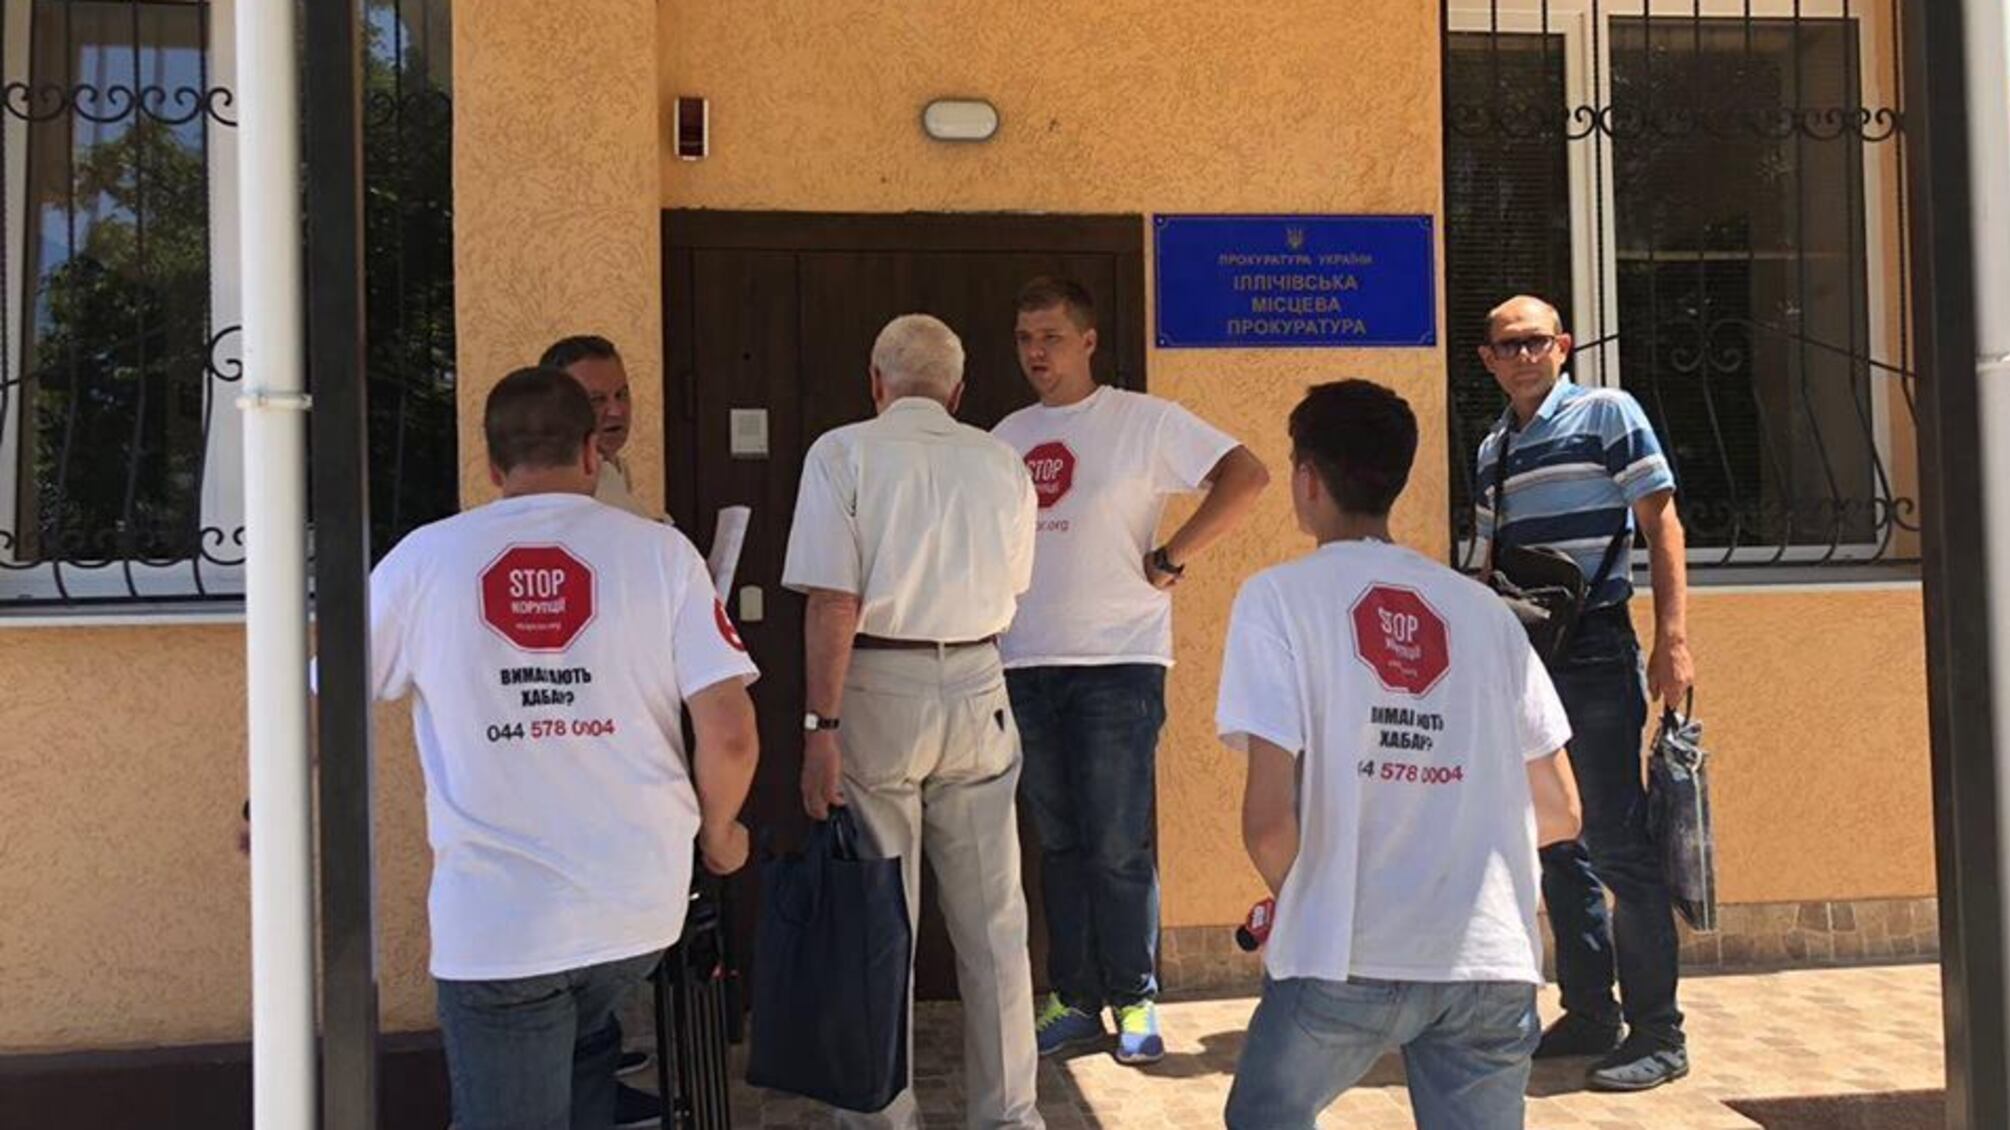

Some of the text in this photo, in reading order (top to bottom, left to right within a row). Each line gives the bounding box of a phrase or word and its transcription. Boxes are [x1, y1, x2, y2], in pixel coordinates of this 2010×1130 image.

[1218, 252, 1372, 265] ПРОКУРАТУРА УКРАЇНИ
[1233, 274, 1358, 291] ІЛЛІЧІВСЬКА
[1251, 296, 1341, 314] МІСЦЕВА
[1227, 319, 1367, 336] ПРОКУРАТУРА
[509, 568, 565, 598] STOP
[487, 722, 525, 742] 044
[531, 719, 566, 738] 578
[1380, 761, 1418, 782] 578
